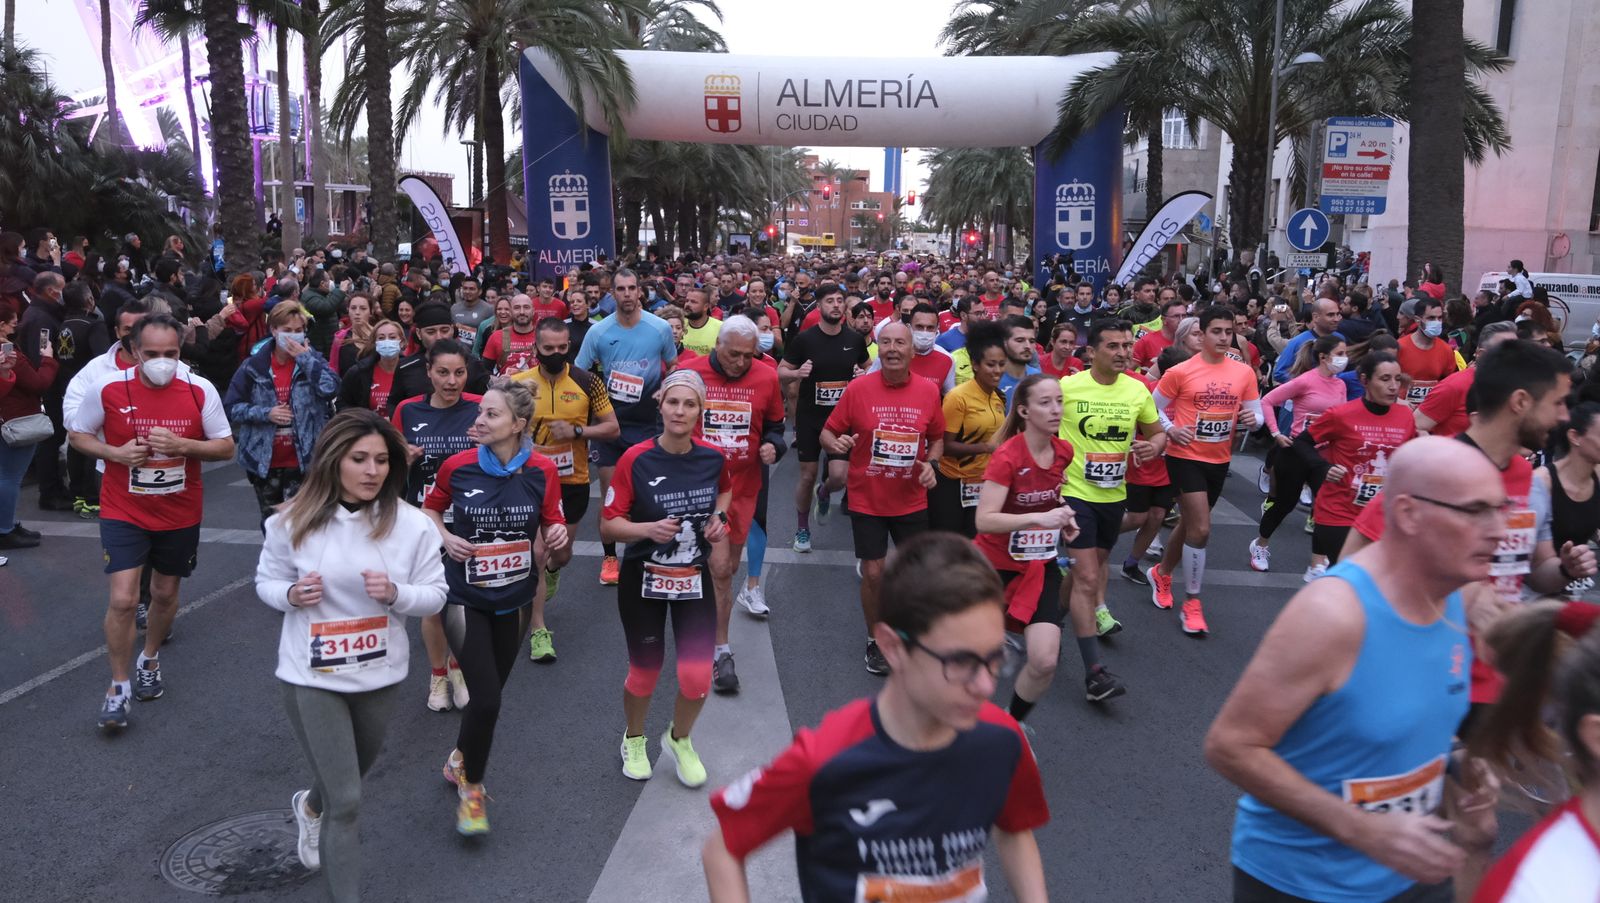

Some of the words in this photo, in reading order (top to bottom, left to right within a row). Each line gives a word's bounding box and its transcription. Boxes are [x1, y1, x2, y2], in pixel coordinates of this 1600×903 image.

[776, 73, 939, 109] ALMERÍA
[776, 114, 858, 132] CIUDAD
[1330, 132, 1347, 152] P
[612, 380, 637, 394] 3113
[822, 388, 843, 398] 477
[712, 413, 744, 423] 3424
[1204, 421, 1229, 433] 403
[881, 442, 911, 454] 3423
[554, 455, 567, 465] 14
[153, 469, 165, 482] 2
[1094, 463, 1121, 476] 427
[967, 485, 982, 495] 34
[1021, 533, 1053, 545] 3112
[479, 555, 522, 572] 3142
[655, 577, 692, 592] 3033
[324, 634, 378, 655] 3140
